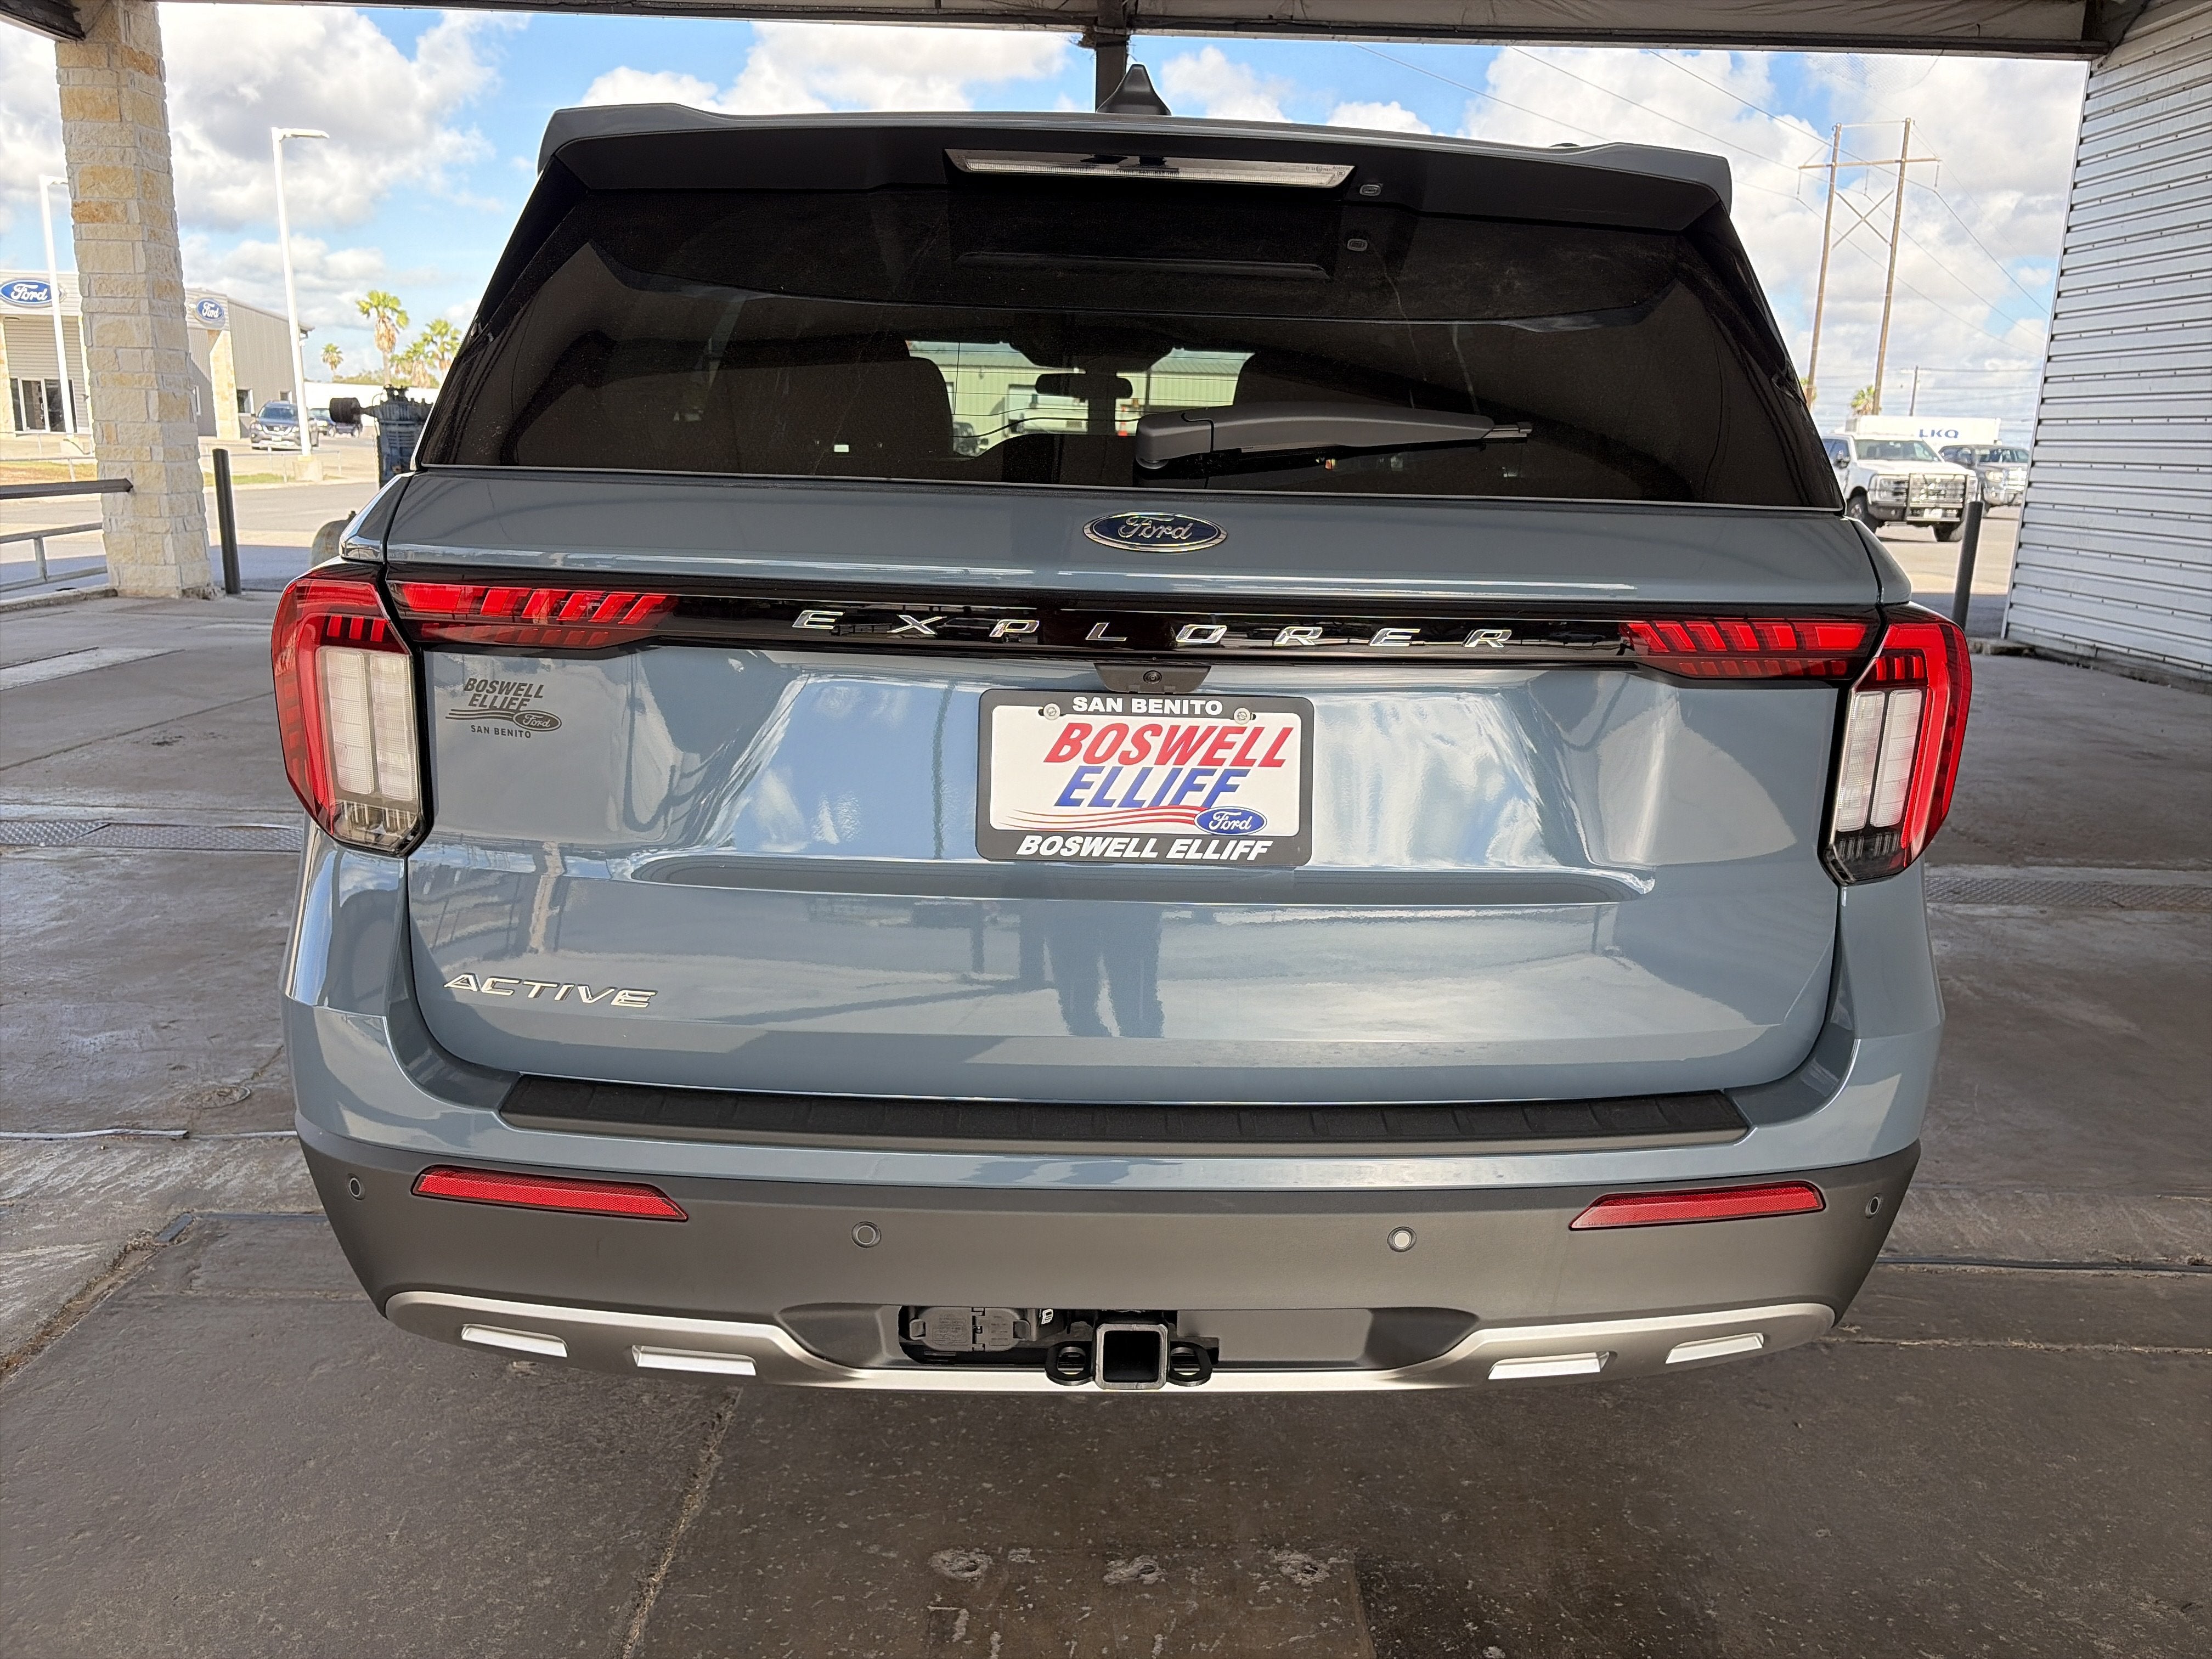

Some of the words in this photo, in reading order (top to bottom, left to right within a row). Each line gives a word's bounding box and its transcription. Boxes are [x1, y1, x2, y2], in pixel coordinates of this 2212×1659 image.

[10, 283, 48, 301] Ford
[202, 302, 219, 318] Ford
[1919, 429, 1959, 438] LKQ
[1118, 516, 1193, 539] Ford
[464, 678, 544, 698] BOSWELL
[468, 693, 531, 711] ELLIFF
[1073, 696, 1124, 713] SAN
[1131, 698, 1223, 715] BENITO
[523, 714, 551, 728] Ford
[471, 725, 489, 734] SAN
[494, 727, 531, 738] BENITO
[1043, 723, 1294, 768] BOSWELL
[1054, 766, 1251, 809] ELLIFF
[1209, 811, 1253, 832] Ford
[1017, 835, 1161, 859] BOSWELL
[1166, 838, 1273, 861] ELLIFF
[443, 973, 657, 1008] ACTIVE
